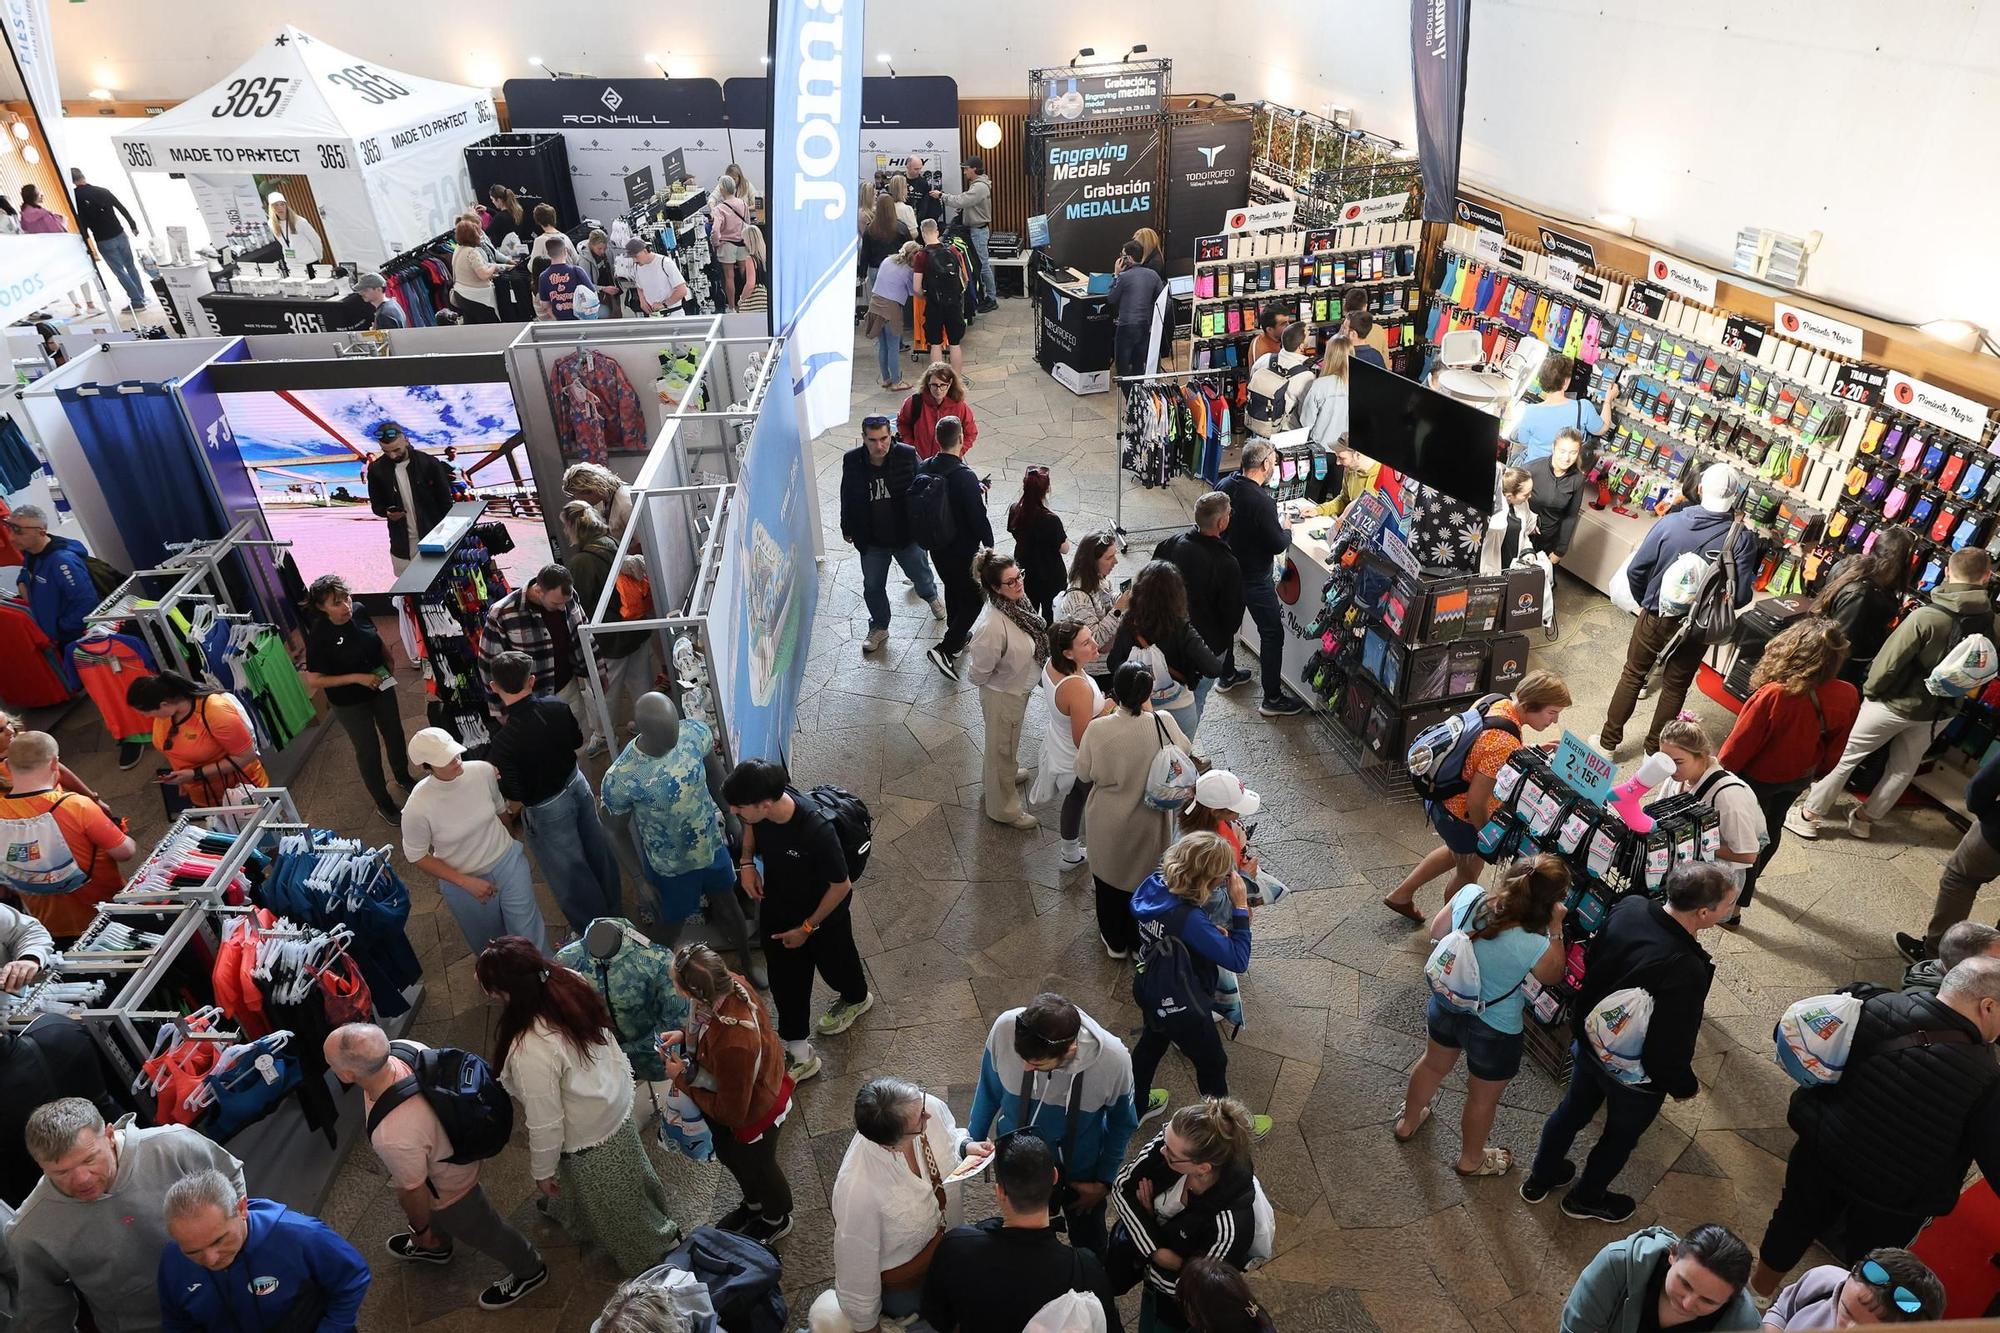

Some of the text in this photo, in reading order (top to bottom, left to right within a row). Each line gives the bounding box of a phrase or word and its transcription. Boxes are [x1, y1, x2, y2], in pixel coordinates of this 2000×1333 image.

[328, 65, 410, 105] 365
[1104, 75, 1148, 88] Grabación
[1118, 86, 1156, 98] medalla
[212, 77, 289, 118] 365
[475, 100, 491, 124] 365
[562, 115, 670, 124] RONHILL
[391, 132, 417, 149] MADE
[419, 124, 433, 139] TO
[123, 143, 151, 167] 365
[169, 148, 212, 162] MADE
[213, 149, 234, 162] TO
[317, 144, 345, 169] 365
[360, 137, 381, 165] 365
[1050, 143, 1128, 167] Engraving
[1053, 160, 1112, 180] Medals
[1083, 179, 1151, 200] Grabación
[1066, 195, 1151, 220] MEDALLAS
[1201, 246, 1224, 259] 2x15€
[1309, 239, 1332, 250] 2x15€
[283, 312, 321, 334] 365
[1802, 321, 1853, 345] Pimiento Negro
[1850, 369, 1884, 387] TRAIL RUN
[1917, 393, 1974, 423] Pimiento Negro
[1351, 506, 1362, 520] 2
[1360, 494, 1385, 517] OFERTA
[1287, 611, 1308, 639] Negr
[1563, 737, 1586, 758] CALCETÍN
[1565, 753, 1576, 770] 2
[1581, 767, 1600, 788] 15€
[1584, 751, 1612, 779] IBIZA
